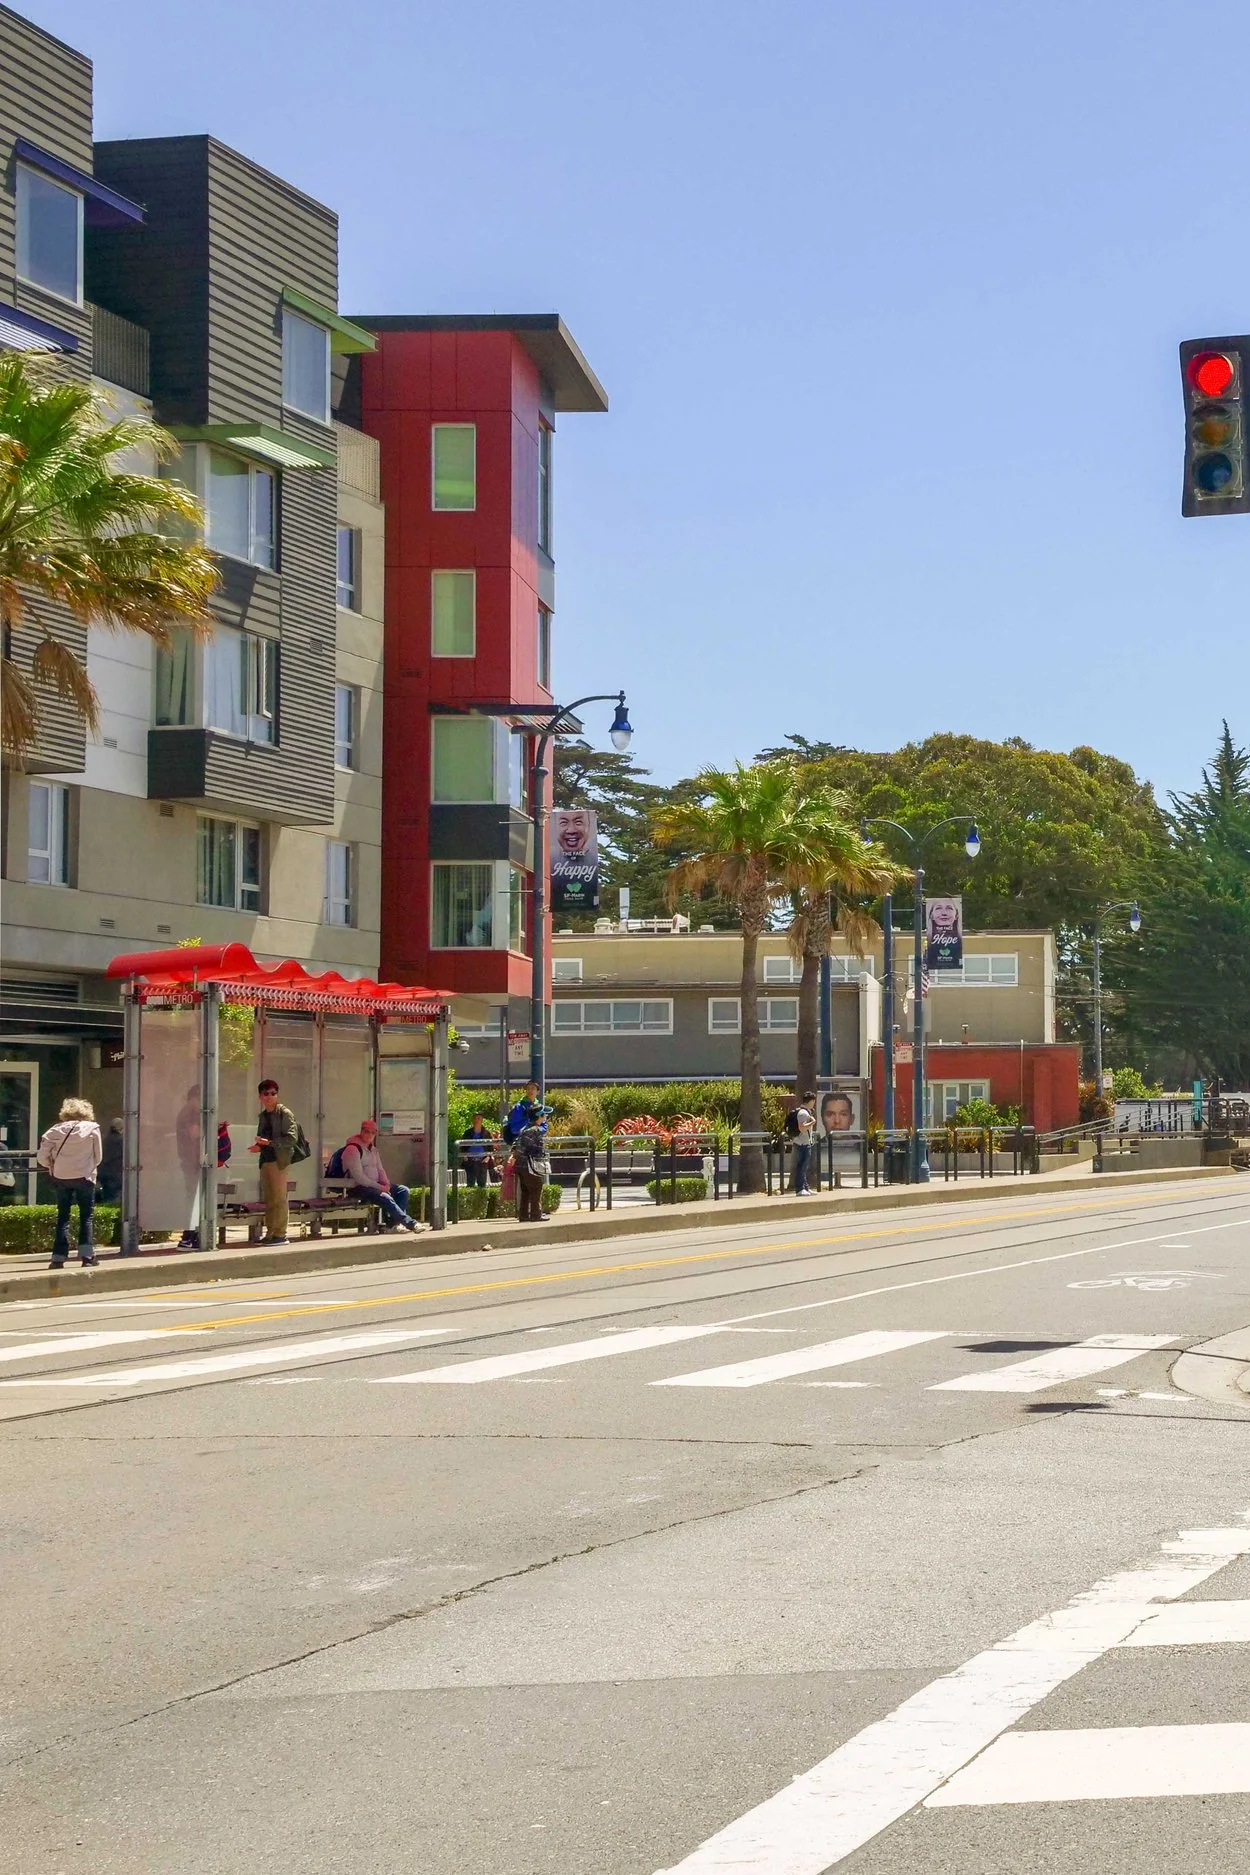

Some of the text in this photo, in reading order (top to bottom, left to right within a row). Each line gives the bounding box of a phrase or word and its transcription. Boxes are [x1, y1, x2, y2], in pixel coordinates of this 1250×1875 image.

[551, 861, 597, 882] Happy
[930, 933, 958, 947] Hope
[163, 993, 194, 1005] METRO
